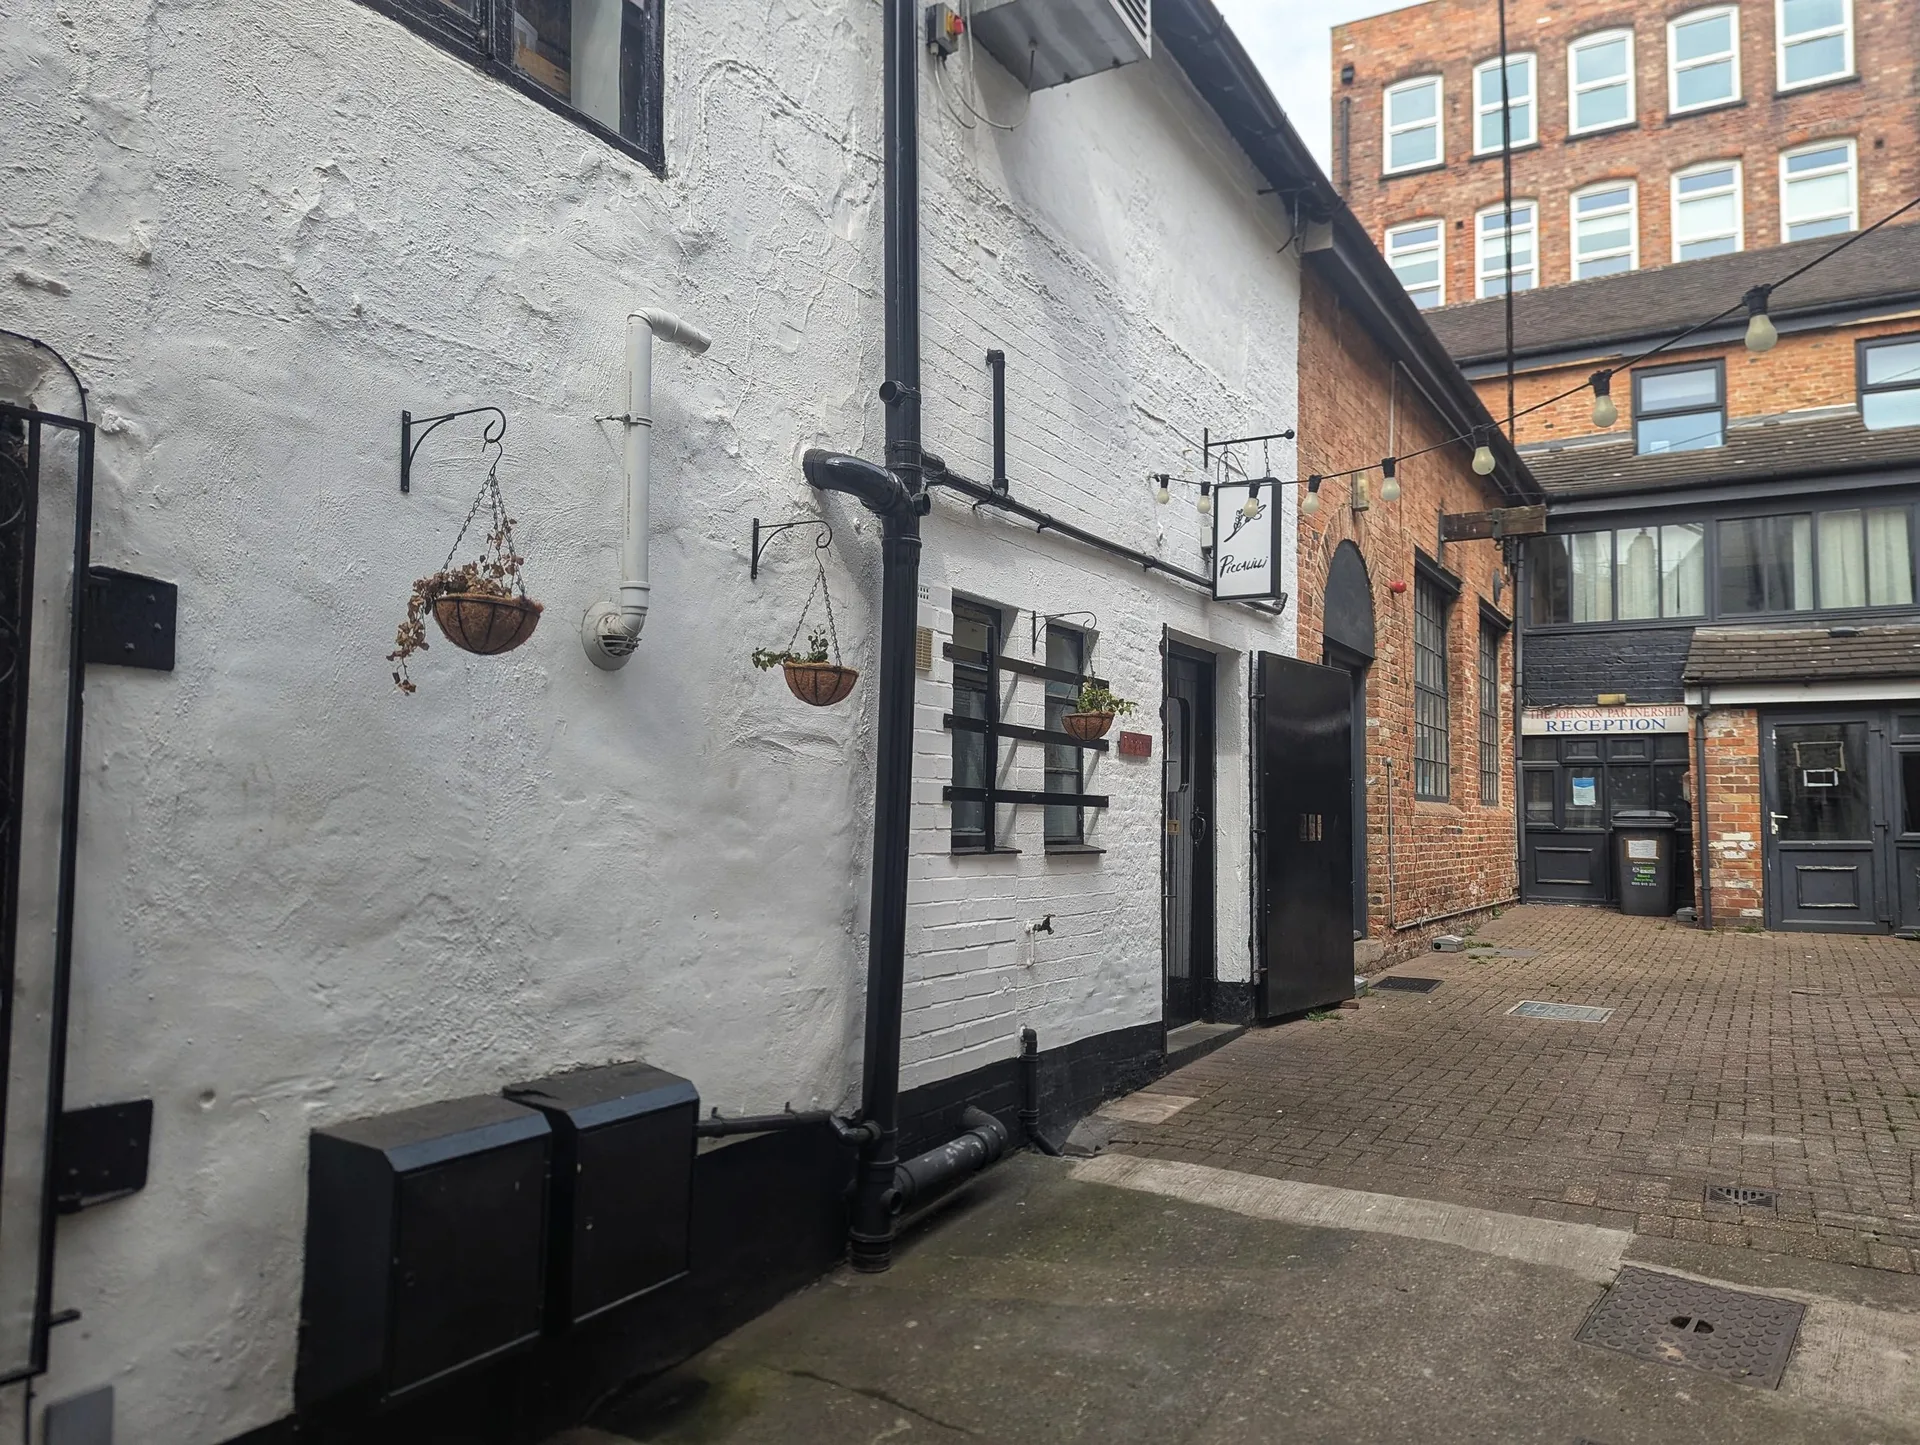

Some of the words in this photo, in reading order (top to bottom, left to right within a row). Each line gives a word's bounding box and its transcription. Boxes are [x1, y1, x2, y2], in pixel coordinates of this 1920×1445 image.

[1530, 709, 1550, 719] THE
[1554, 708, 1603, 719] JOHNSON
[1607, 706, 1684, 718] PARTNERSHIP
[1546, 718, 1666, 732] RECEPTION
